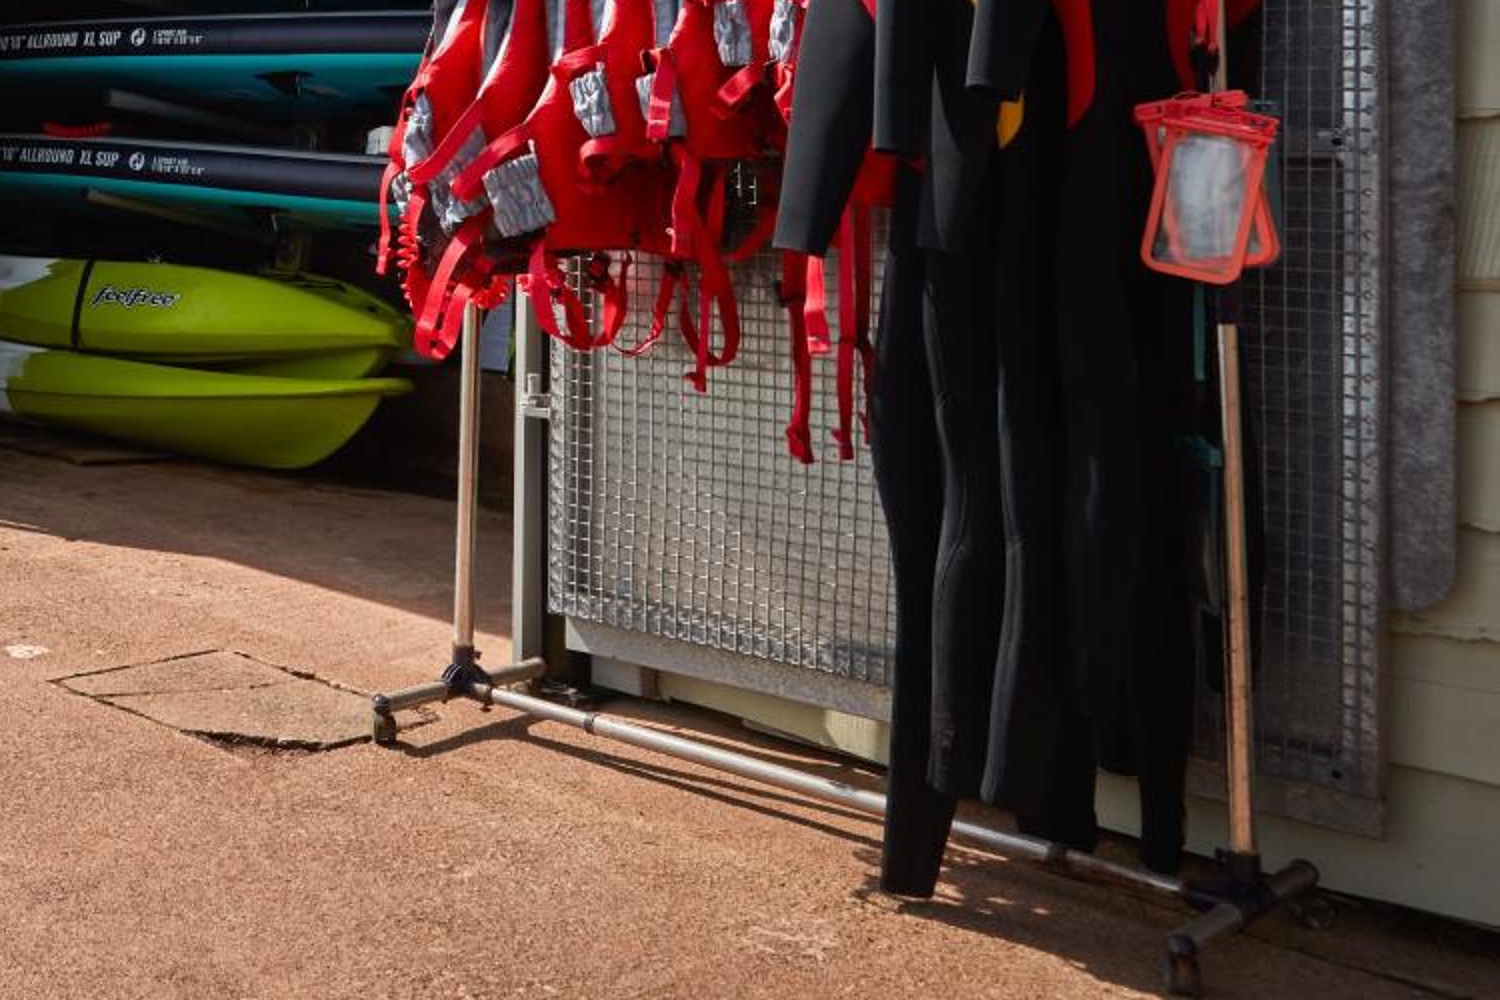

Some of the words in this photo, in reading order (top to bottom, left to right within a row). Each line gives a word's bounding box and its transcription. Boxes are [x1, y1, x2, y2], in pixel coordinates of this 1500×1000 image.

[27, 33, 79, 50] ALLROUND
[83, 31, 97, 47] XL
[99, 30, 122, 45] SUP
[20, 148, 75, 165] ALLROUND
[79, 150, 93, 166] XL
[95, 152, 119, 168] SUP
